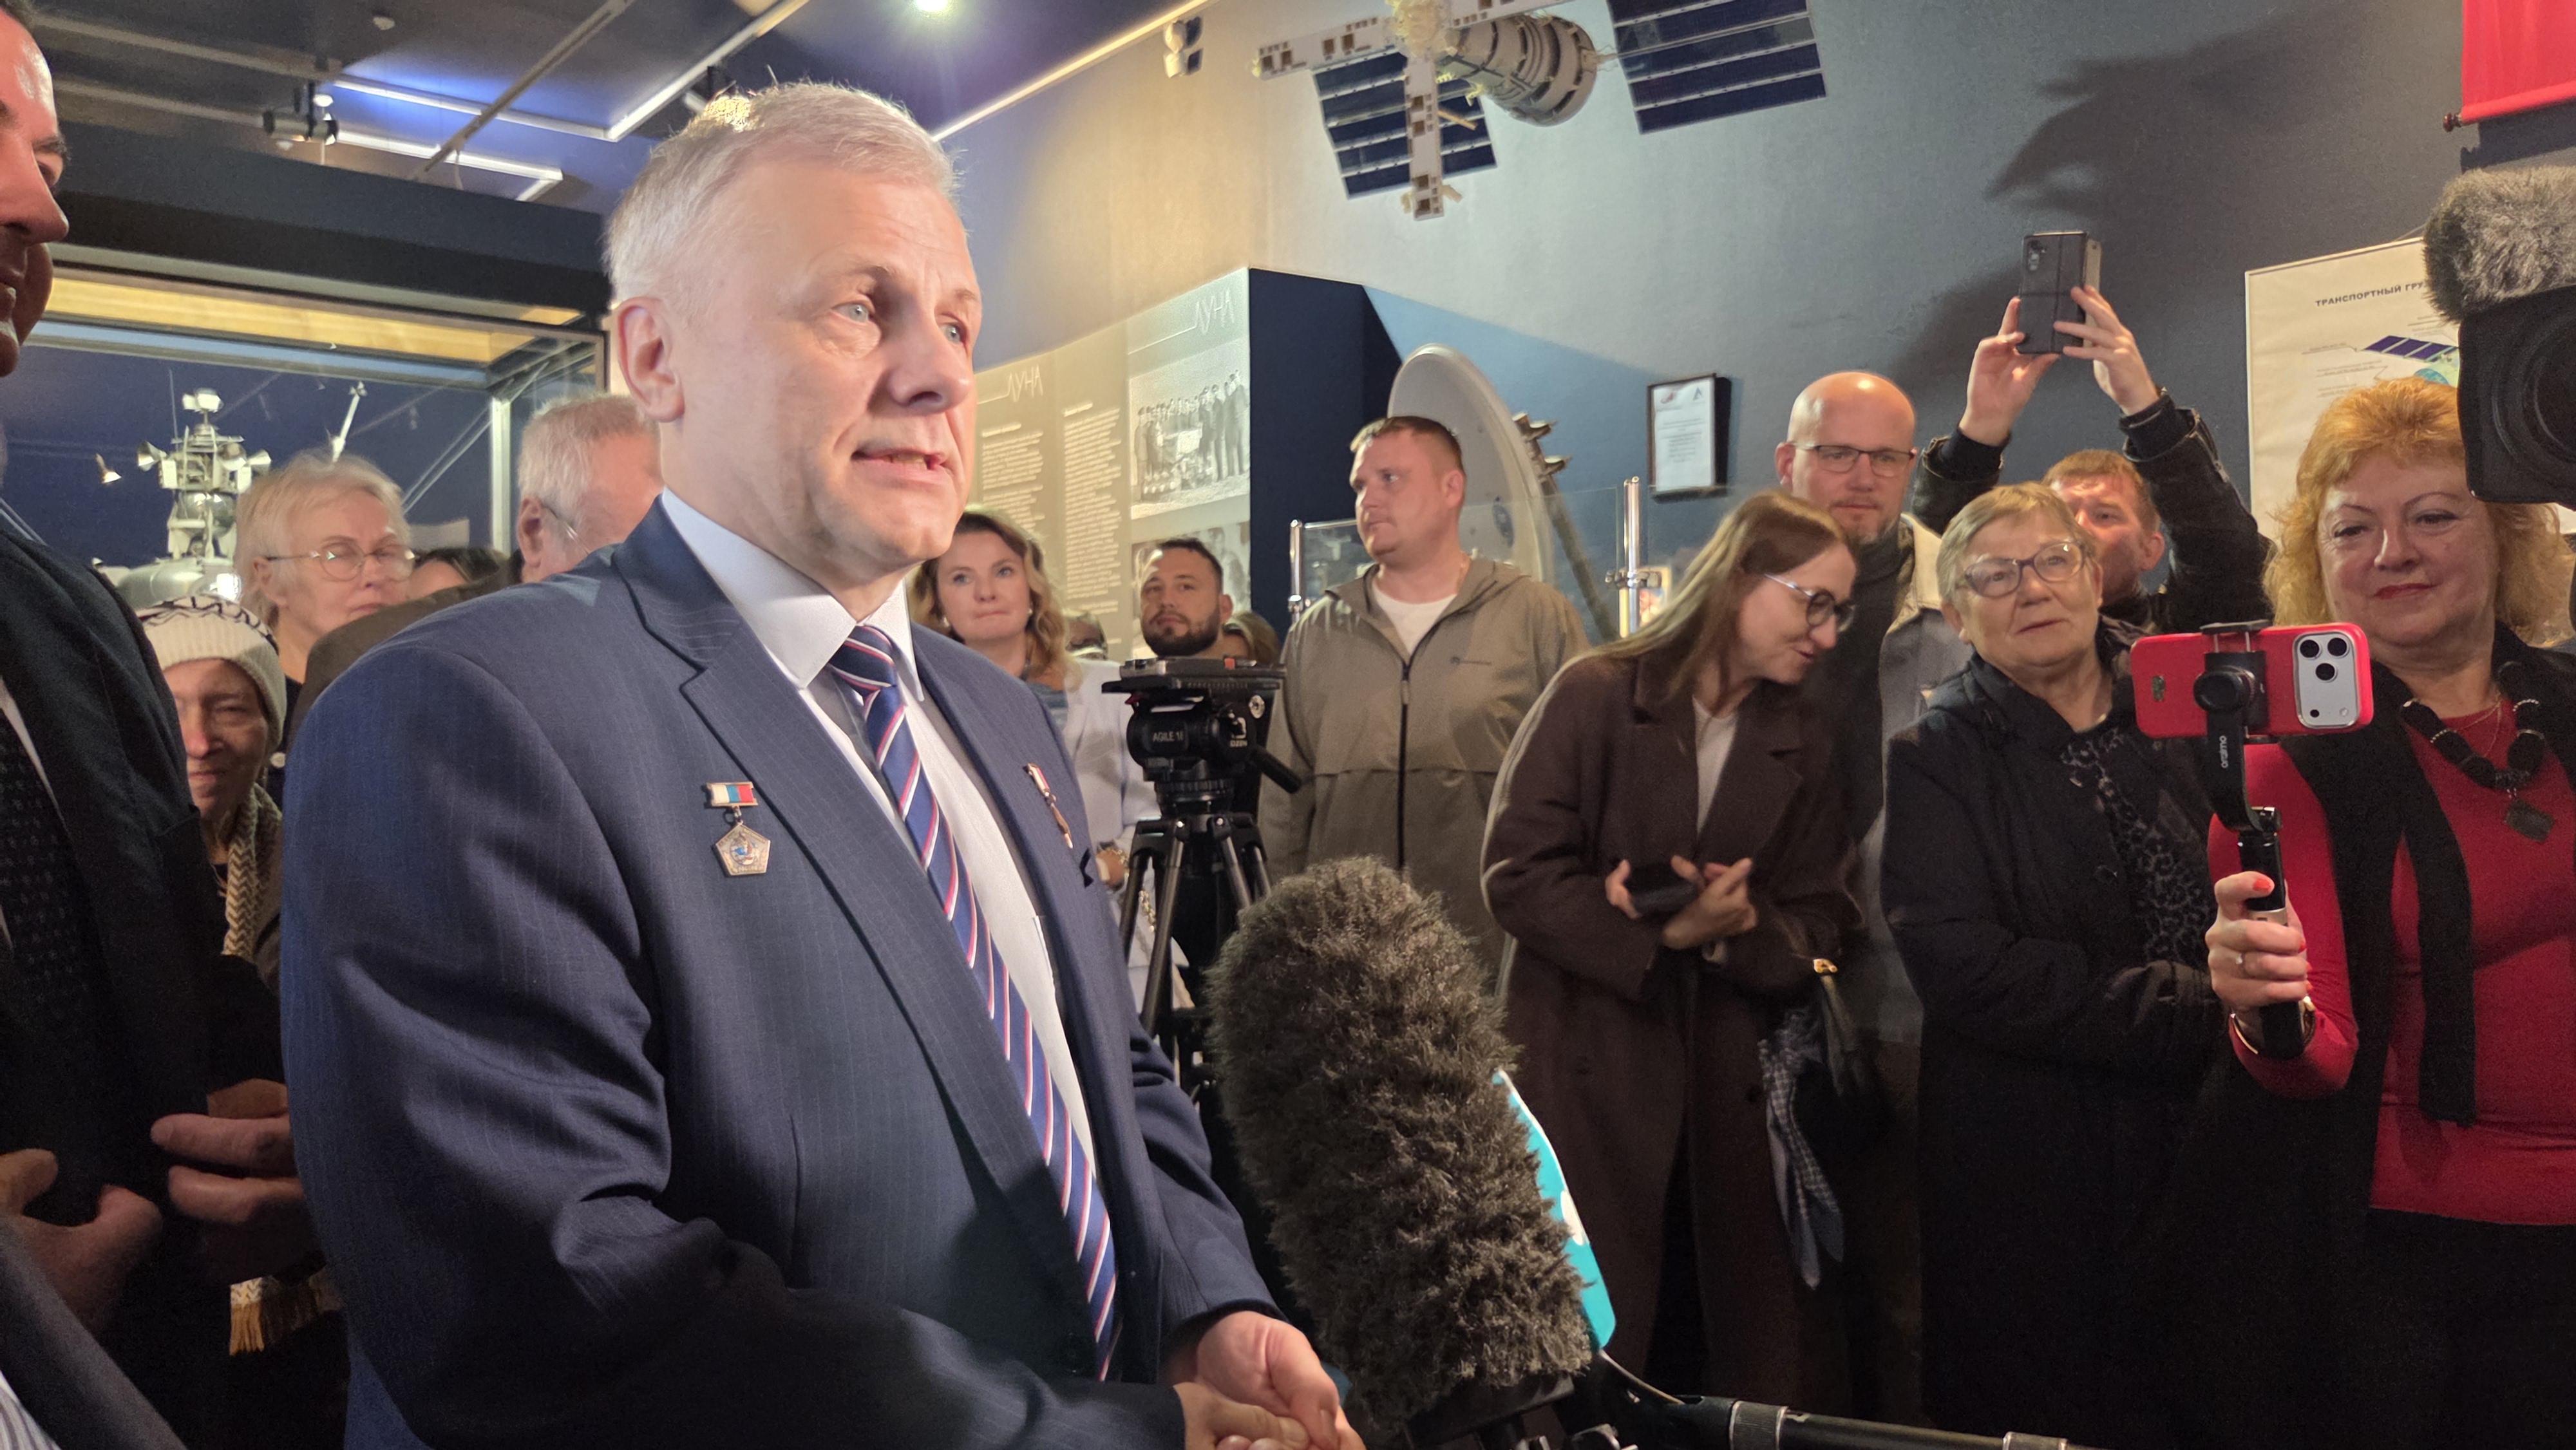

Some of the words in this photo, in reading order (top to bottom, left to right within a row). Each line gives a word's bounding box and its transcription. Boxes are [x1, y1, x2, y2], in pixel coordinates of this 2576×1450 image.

[1195, 288, 1235, 334] ЛУНА
[2315, 284, 2401, 307] ТРАНСПОРТНЫЙ
[1007, 363, 1043, 402] ЛУНА
[1153, 731, 1175, 742] AGILE
